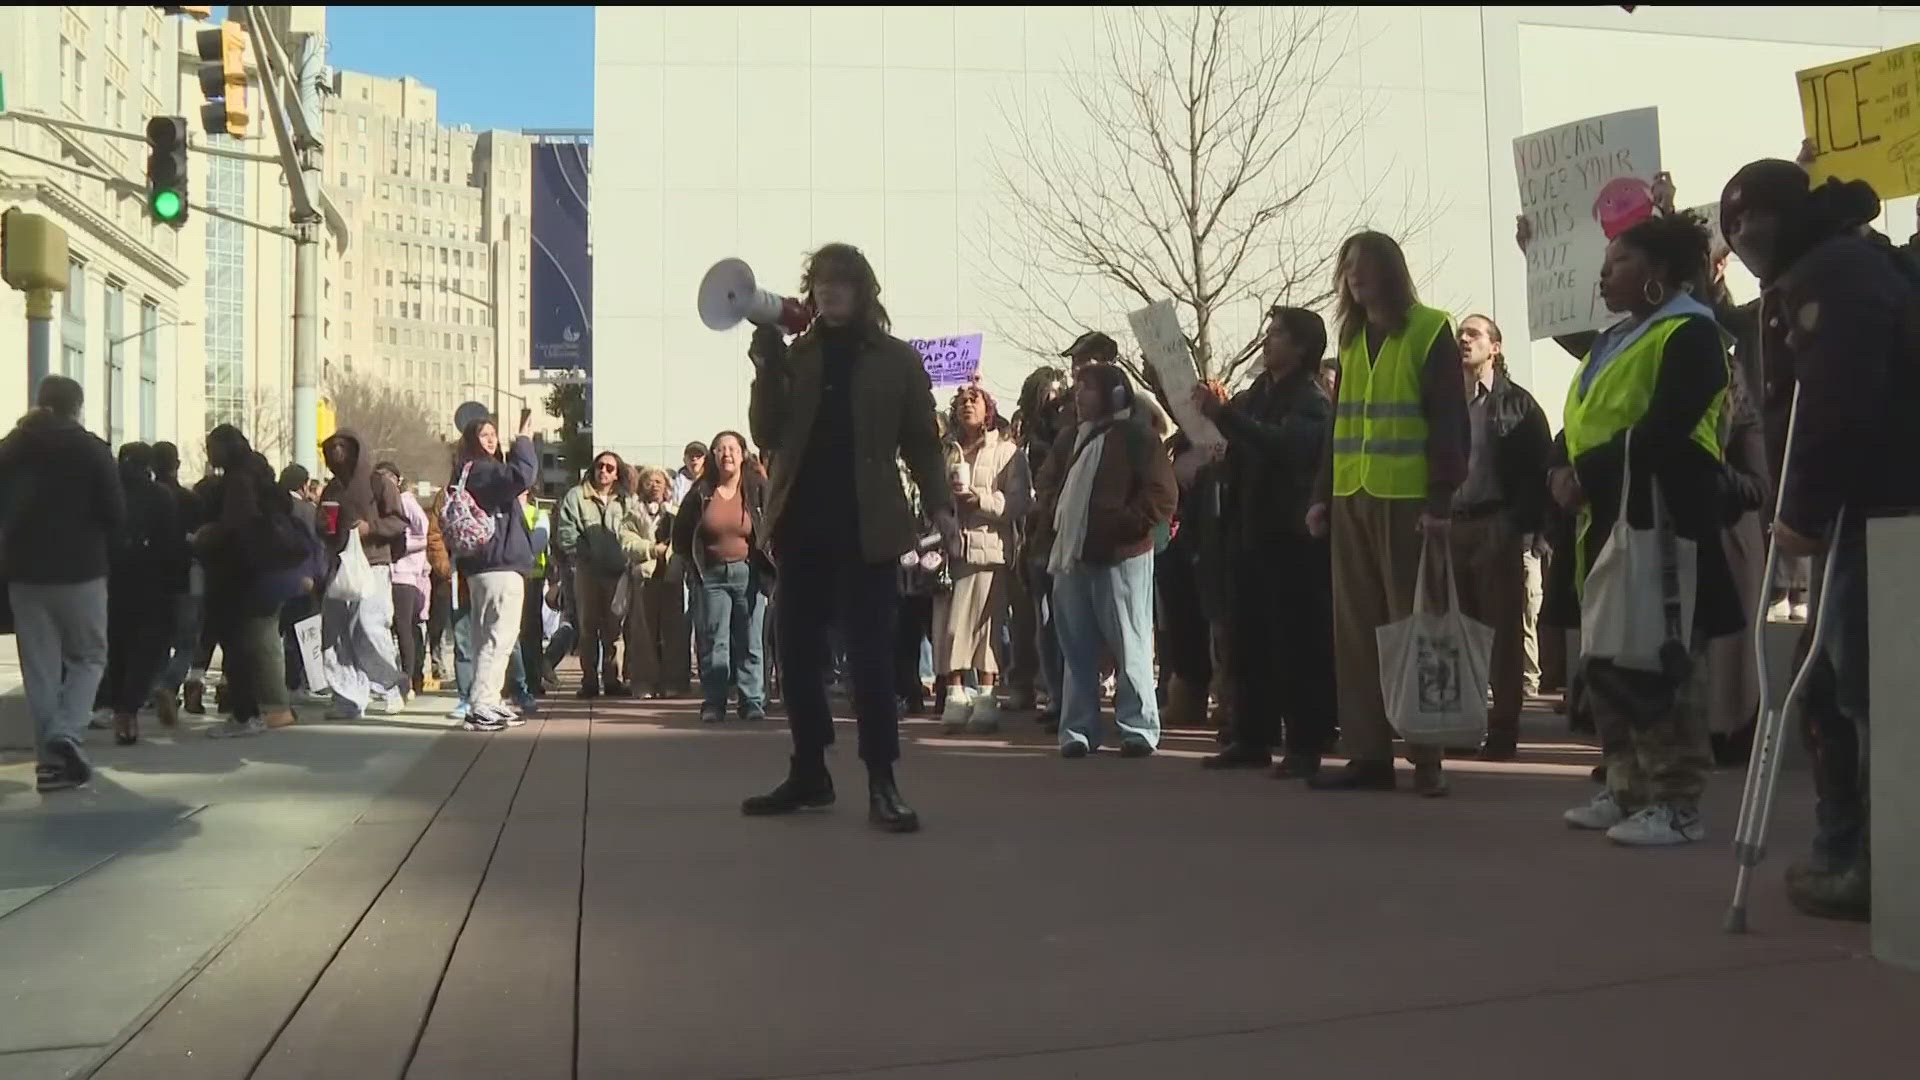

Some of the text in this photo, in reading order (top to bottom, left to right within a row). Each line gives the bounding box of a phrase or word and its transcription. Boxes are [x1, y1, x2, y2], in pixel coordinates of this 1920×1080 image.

[1801, 61, 1881, 157] ICE
[1515, 120, 1604, 178] YOU CAN
[1575, 150, 1634, 190] YOUR
[1534, 203, 1574, 241] ACES
[1527, 242, 1572, 273] BUT
